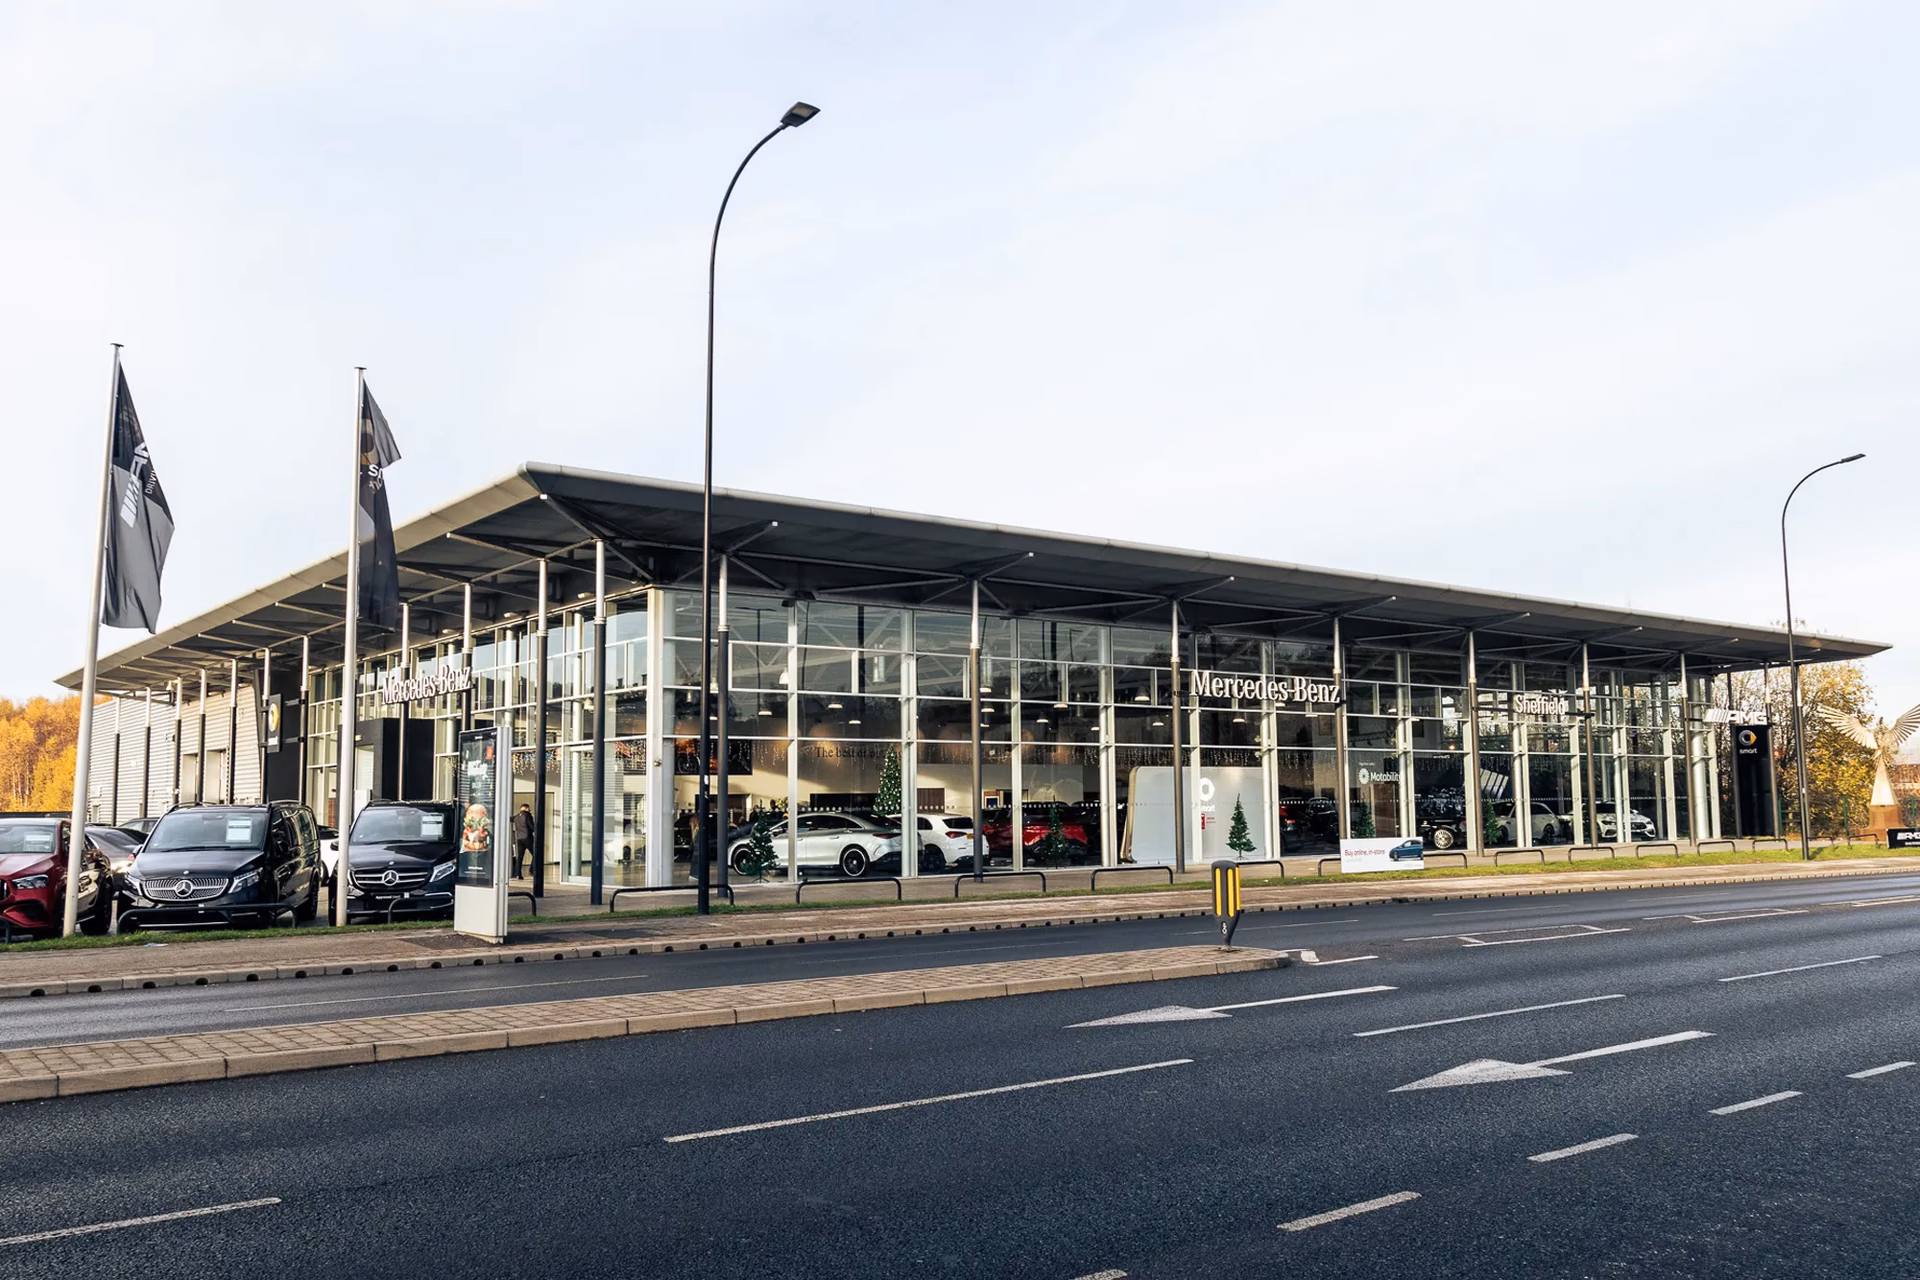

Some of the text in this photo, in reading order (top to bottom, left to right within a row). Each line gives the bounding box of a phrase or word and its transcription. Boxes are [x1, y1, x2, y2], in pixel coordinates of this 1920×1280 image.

[382, 664, 471, 705] Mercedes-Benz
[1189, 669, 1340, 703] Mercedes-Benz
[1515, 694, 1566, 715] Sheffield
[1724, 709, 1769, 725] AMG
[815, 746, 834, 758] The
[1344, 849, 1354, 857] Buy
